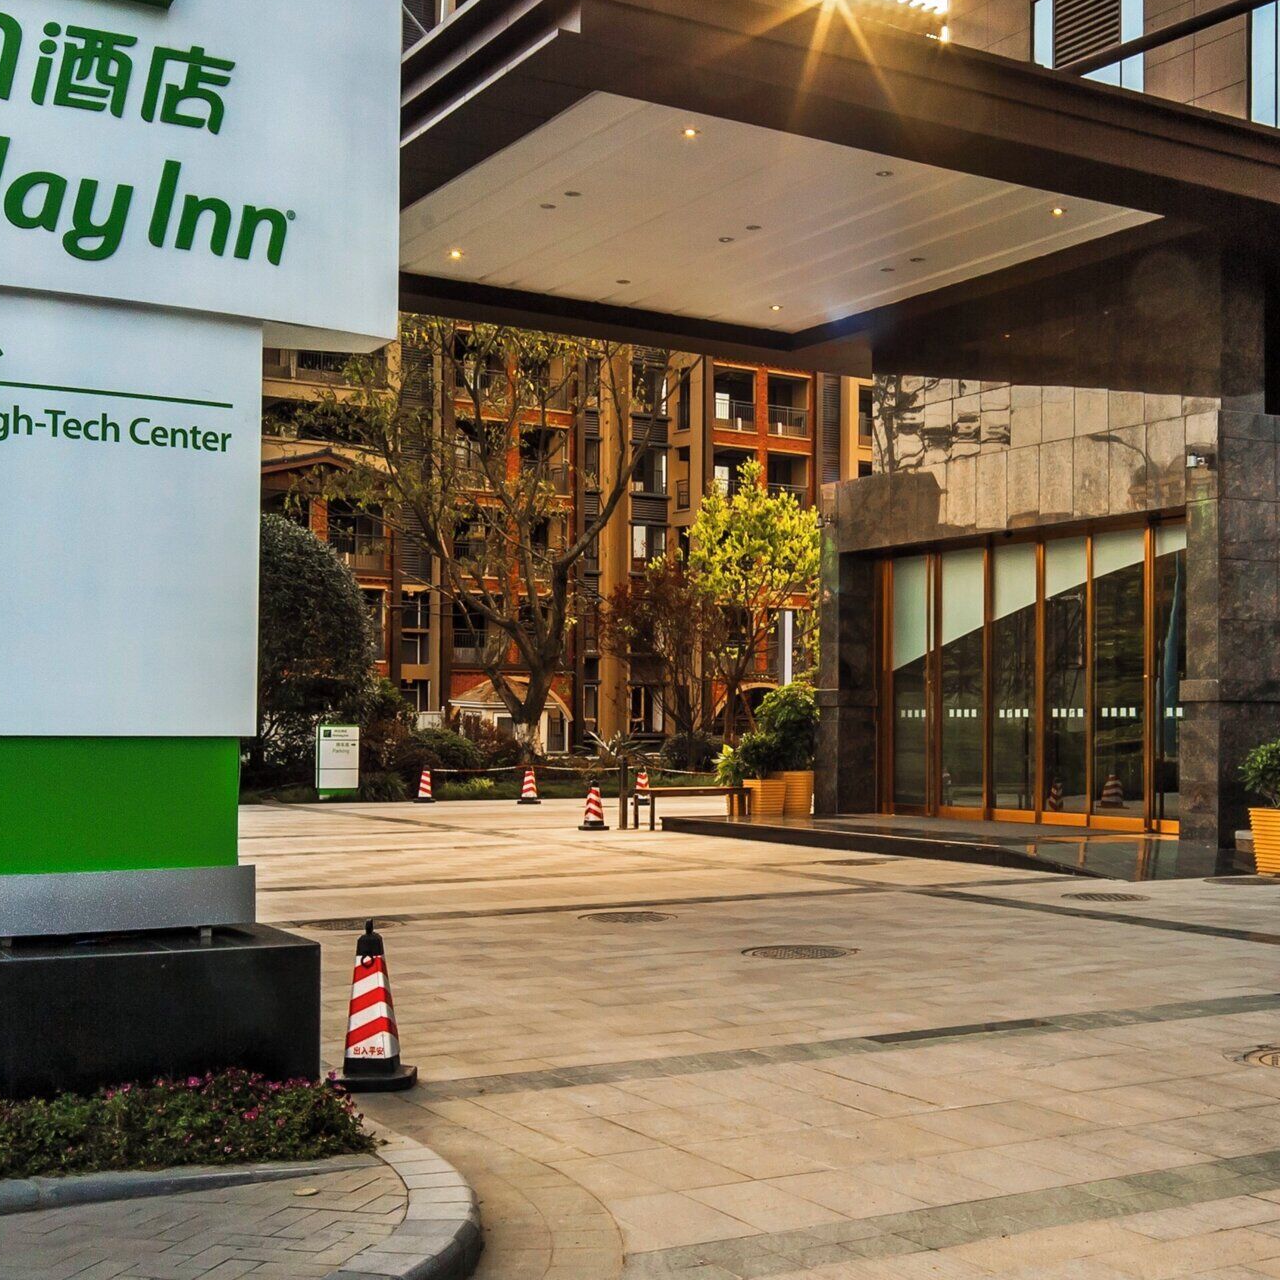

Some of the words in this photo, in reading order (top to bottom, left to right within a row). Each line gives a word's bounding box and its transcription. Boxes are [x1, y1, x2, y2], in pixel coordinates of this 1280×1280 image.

[147, 160, 291, 266] Inn
[129, 417, 232, 452] Center
[353, 1046, 384, 1056] 出入平安
